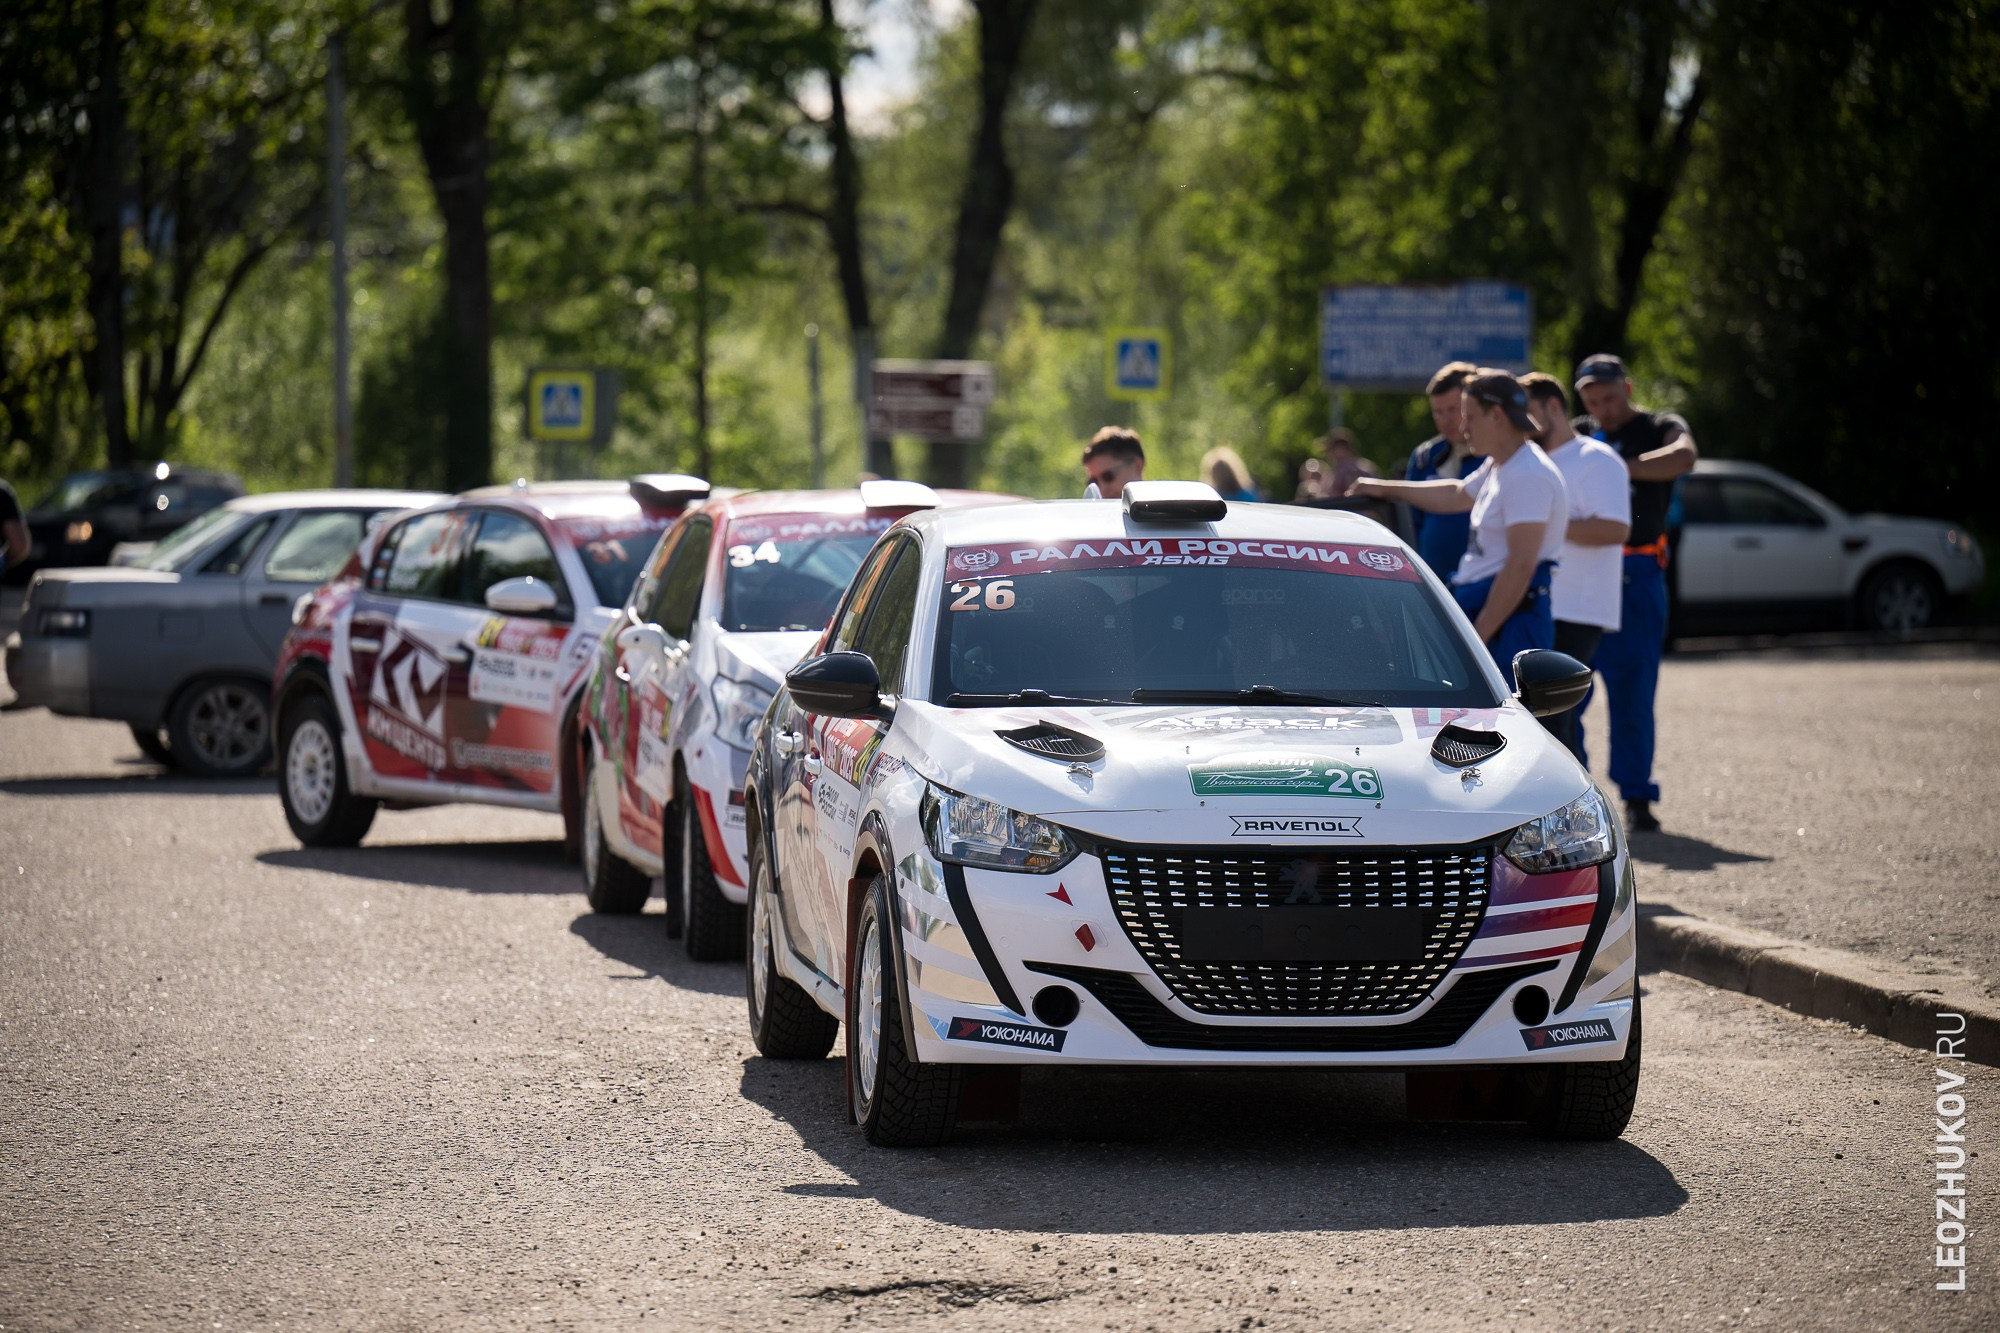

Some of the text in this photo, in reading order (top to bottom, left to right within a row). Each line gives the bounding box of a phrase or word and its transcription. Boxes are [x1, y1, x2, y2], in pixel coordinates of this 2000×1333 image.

[728, 541, 781, 567] 34
[1010, 540, 1350, 565] РАЛЛИ РОССИИ
[950, 579, 1016, 611] 26
[1133, 716, 1367, 728] Attack
[1203, 775, 1320, 788] Пушкинские горы
[1324, 768, 1378, 795] 26
[1244, 819, 1351, 832] RAVENOL
[981, 1024, 1055, 1047] YOKOHAMA
[1548, 1024, 1609, 1043] YOKOHAMA
